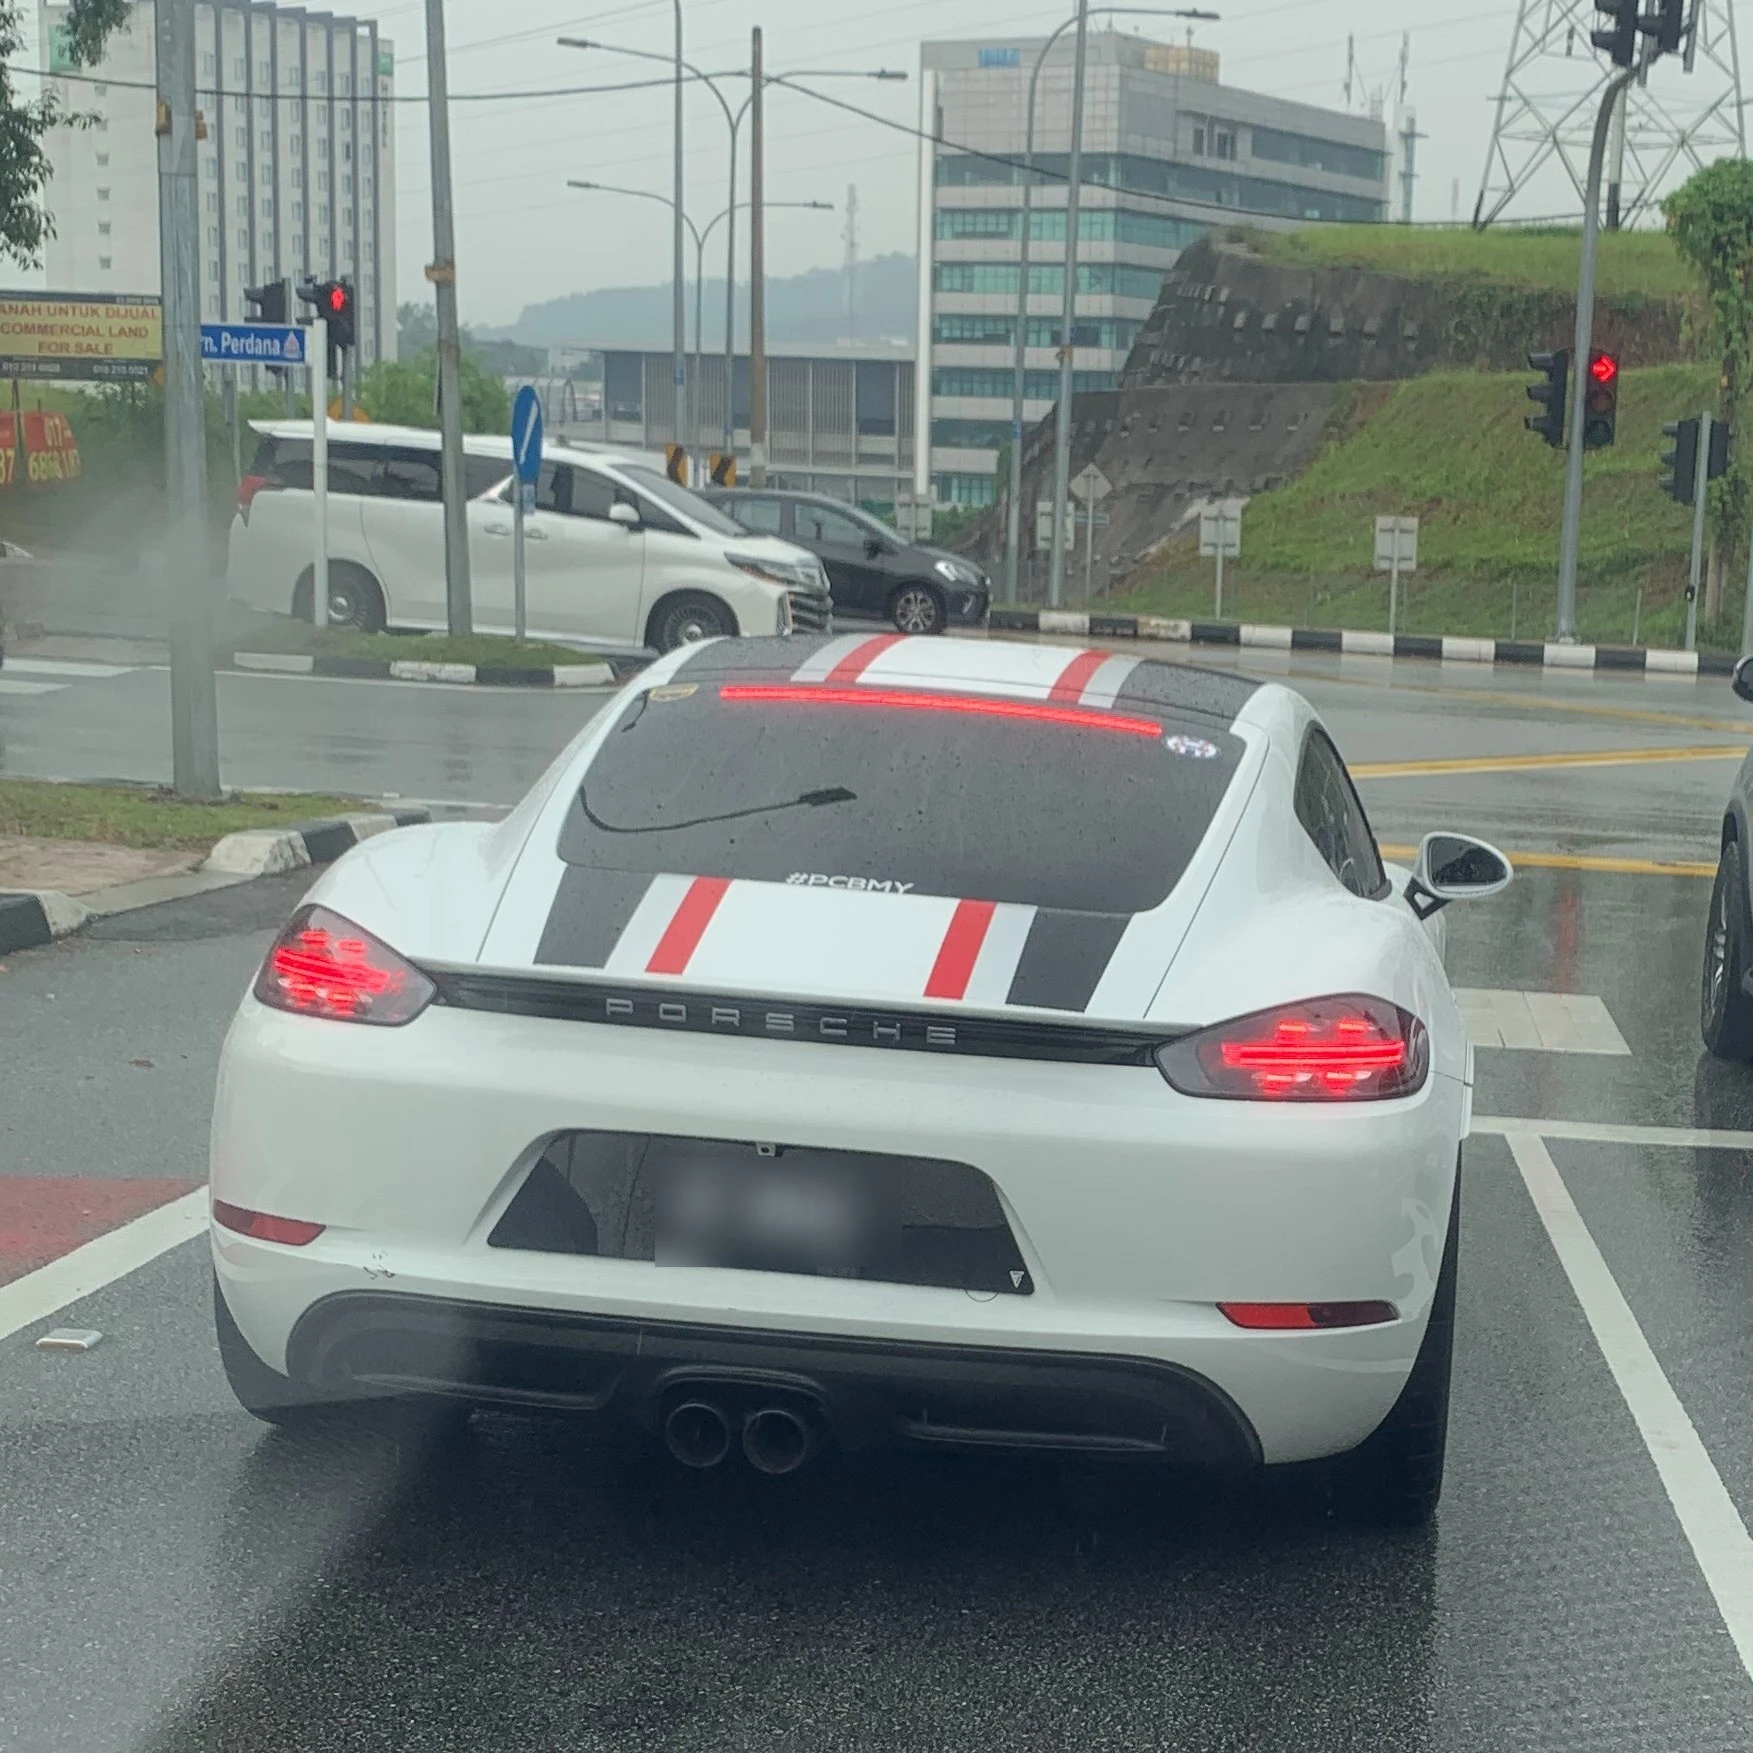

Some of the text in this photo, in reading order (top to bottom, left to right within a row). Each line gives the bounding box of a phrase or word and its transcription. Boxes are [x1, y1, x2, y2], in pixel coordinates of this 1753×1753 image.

[47, 305, 100, 318] UNTUK
[105, 307, 157, 319] DIJUAL
[0, 322, 149, 339] COMMERCIAL LAND
[38, 341, 114, 355] FOR SALE
[221, 331, 281, 356] Perdana
[786, 871, 915, 895] #PCBMY
[605, 997, 956, 1045] PORSCHE
